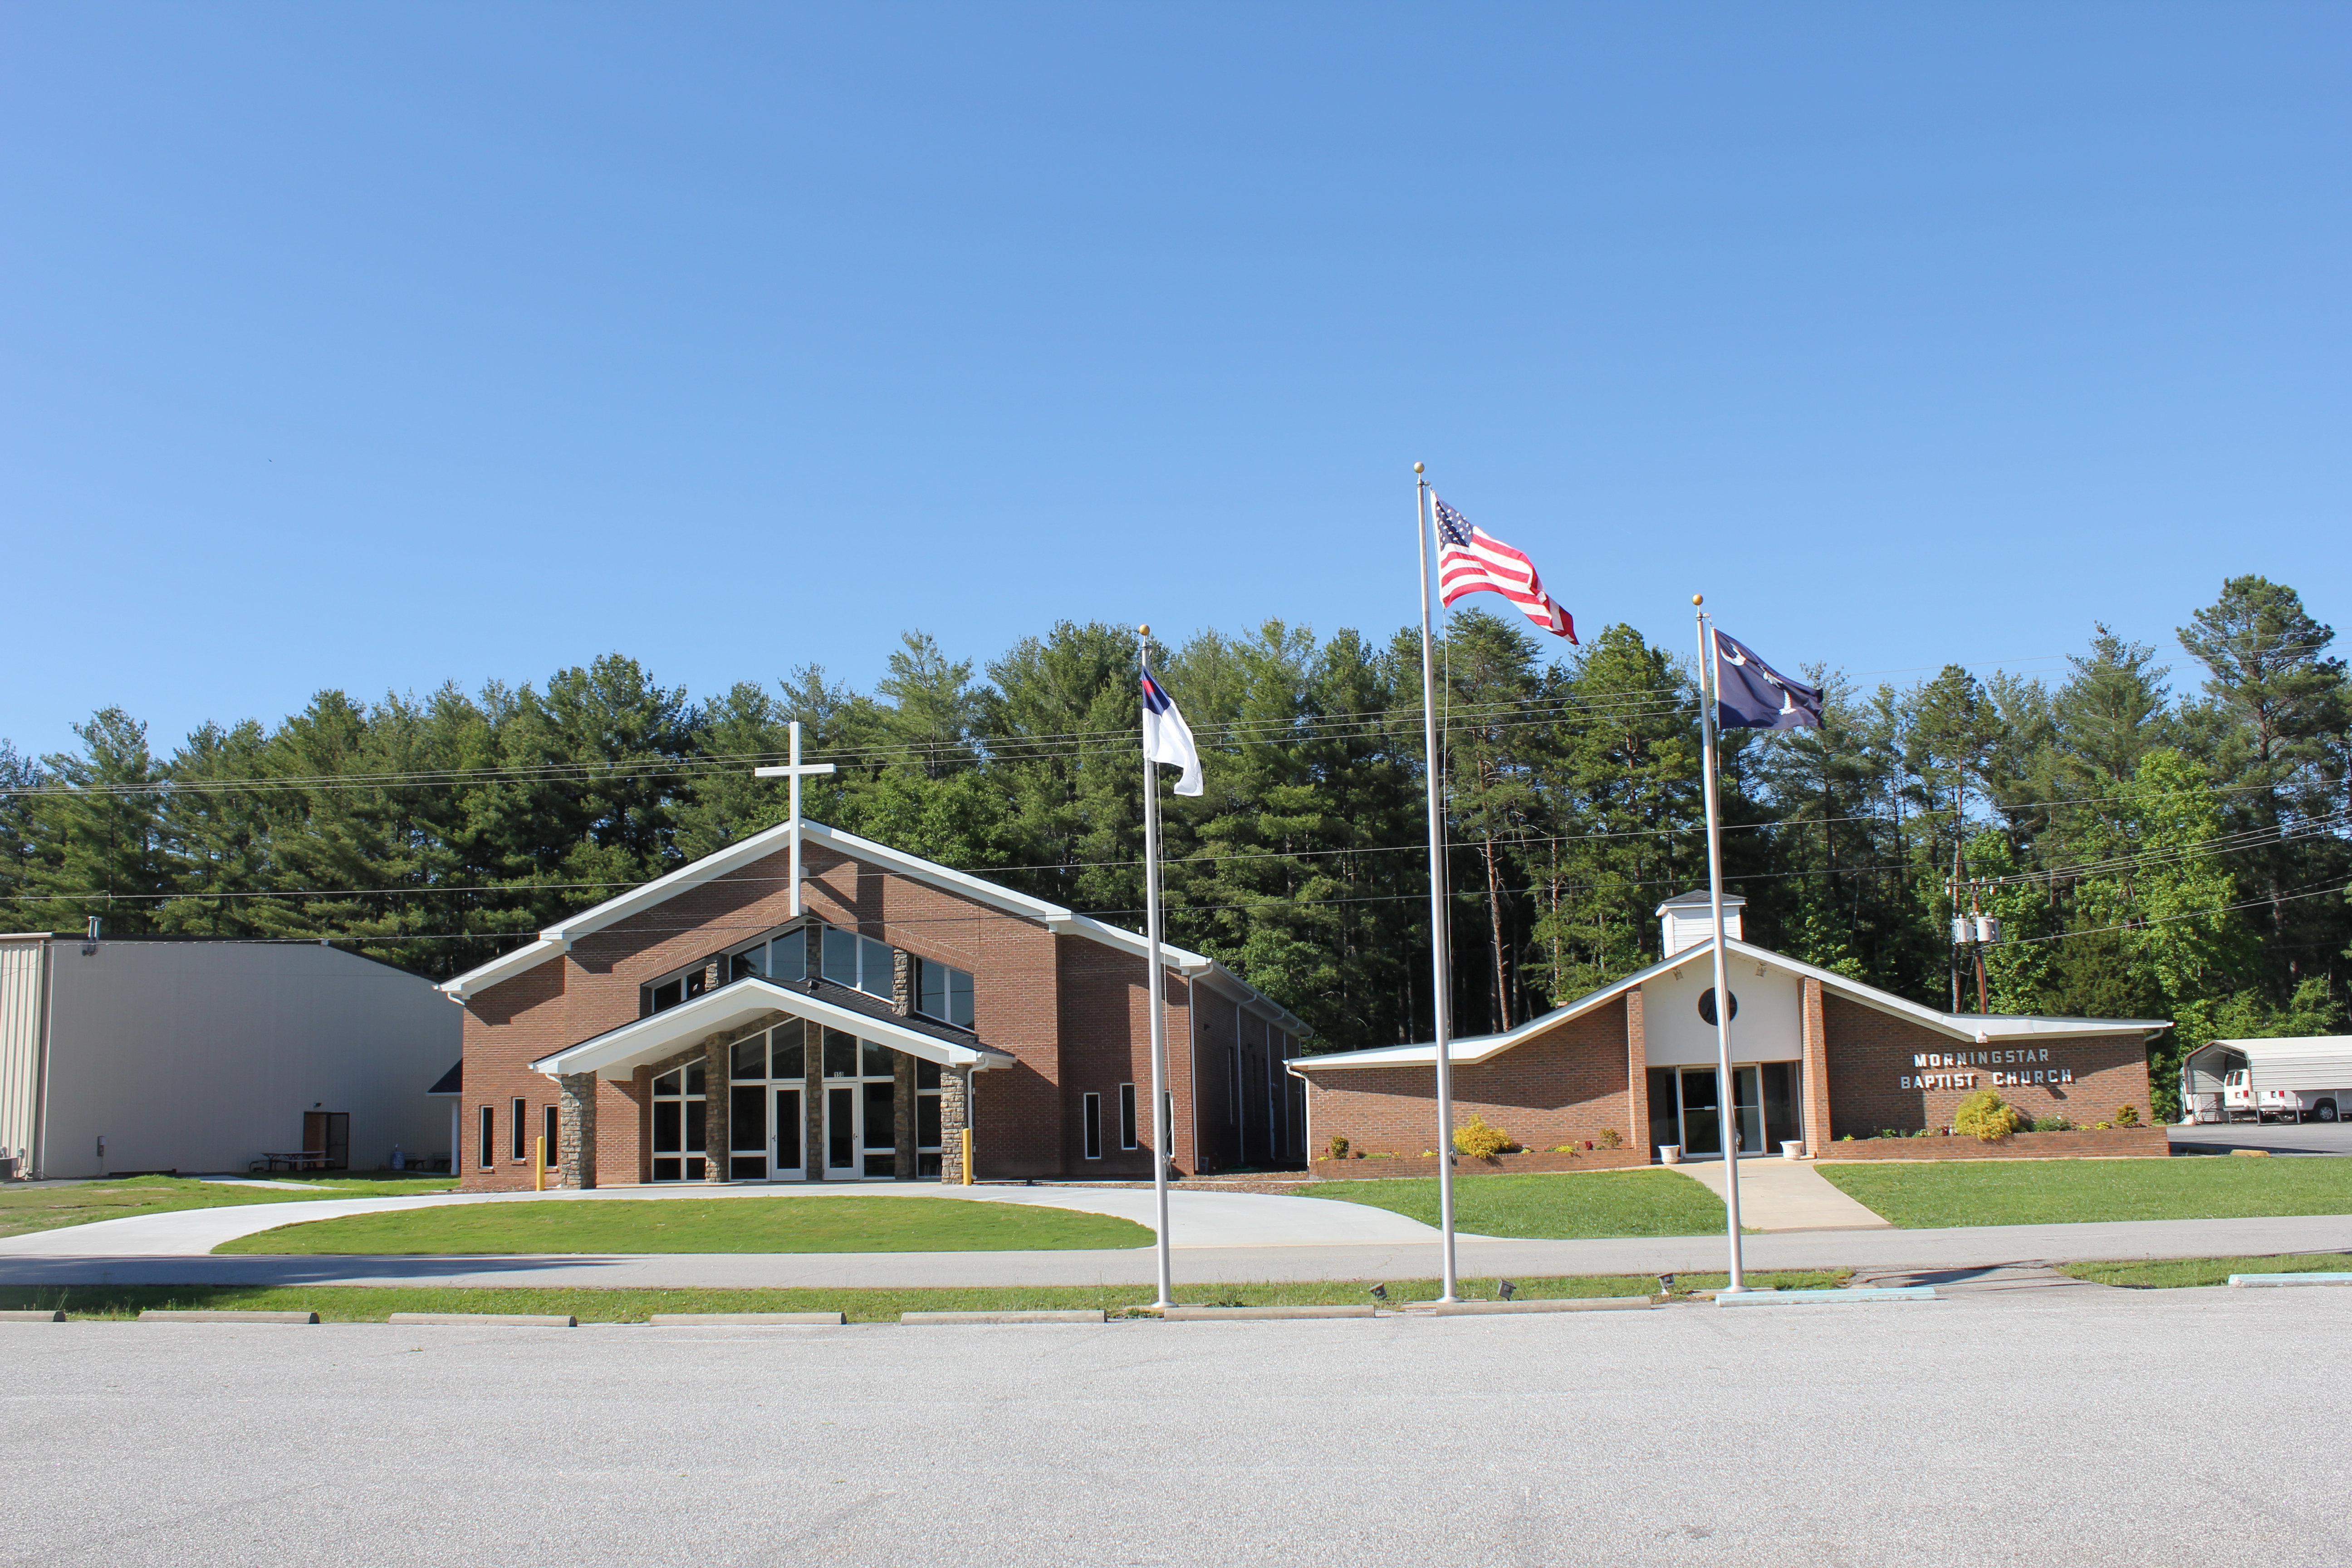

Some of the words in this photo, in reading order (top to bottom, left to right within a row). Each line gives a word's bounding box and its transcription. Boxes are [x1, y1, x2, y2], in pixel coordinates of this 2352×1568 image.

[1914, 1049, 2049, 1067] MORNINGSTAR
[1901, 1073, 1974, 1089] BAPTIST
[1992, 1069, 2072, 1085] CHURCH
